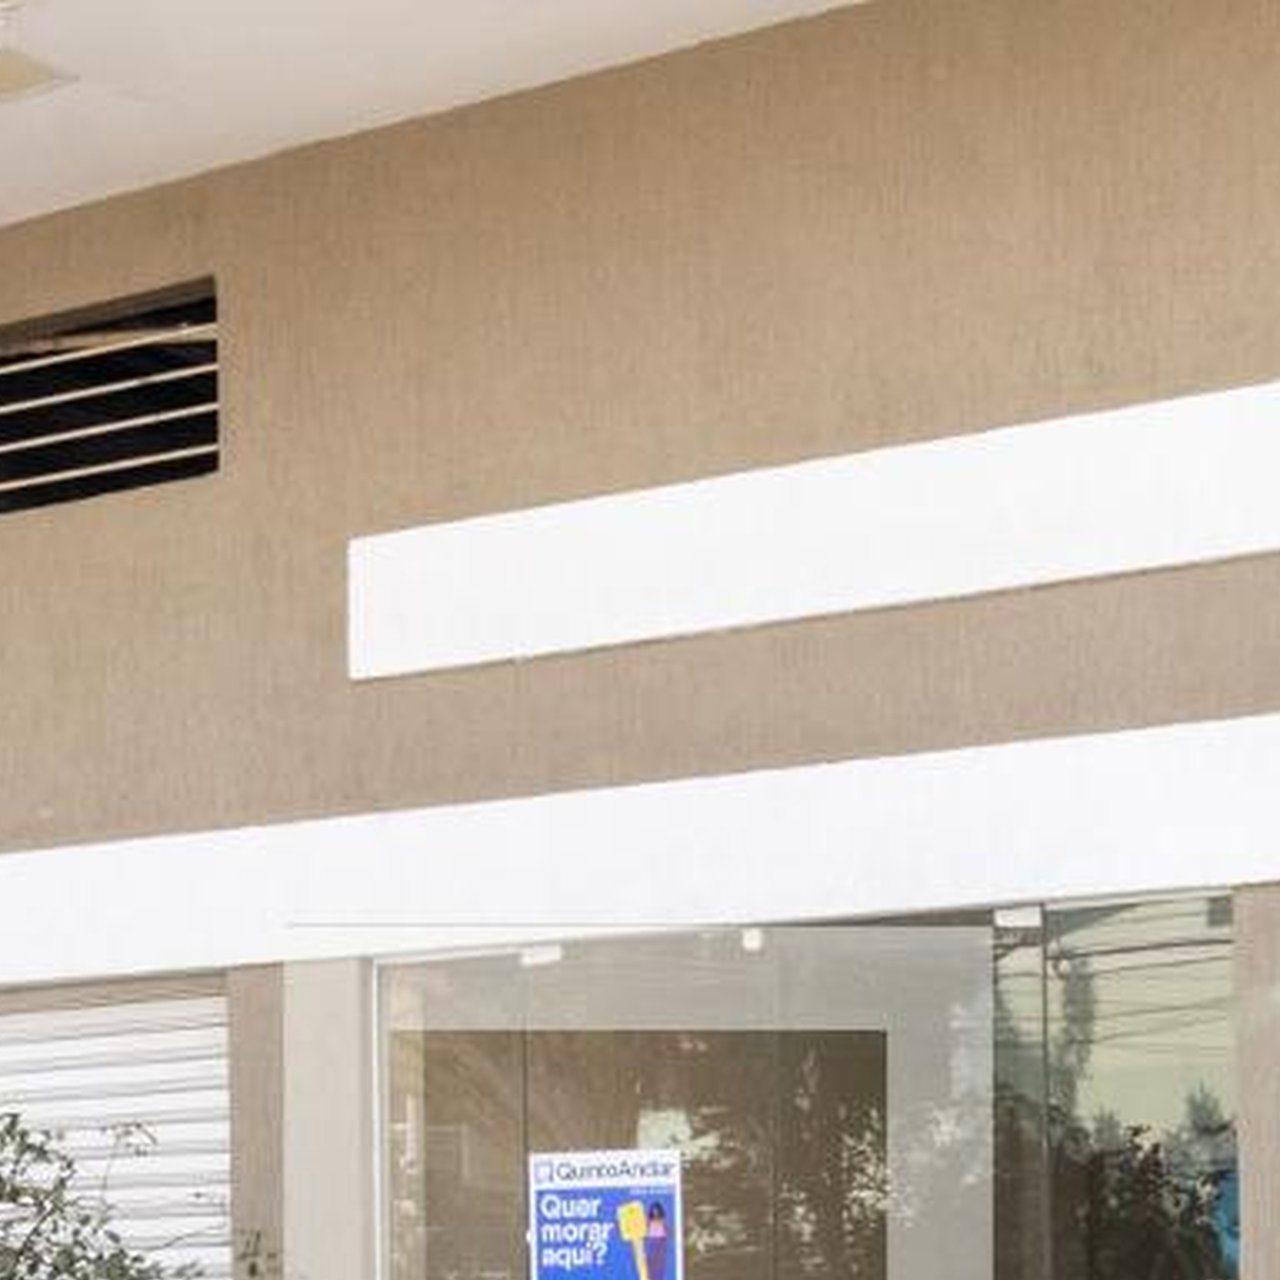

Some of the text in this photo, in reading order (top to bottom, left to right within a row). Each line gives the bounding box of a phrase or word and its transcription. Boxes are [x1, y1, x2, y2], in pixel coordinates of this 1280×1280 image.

[540, 1194, 601, 1219] Quer
[541, 1222, 614, 1243] morar
[542, 1243, 607, 1271] aqui?
